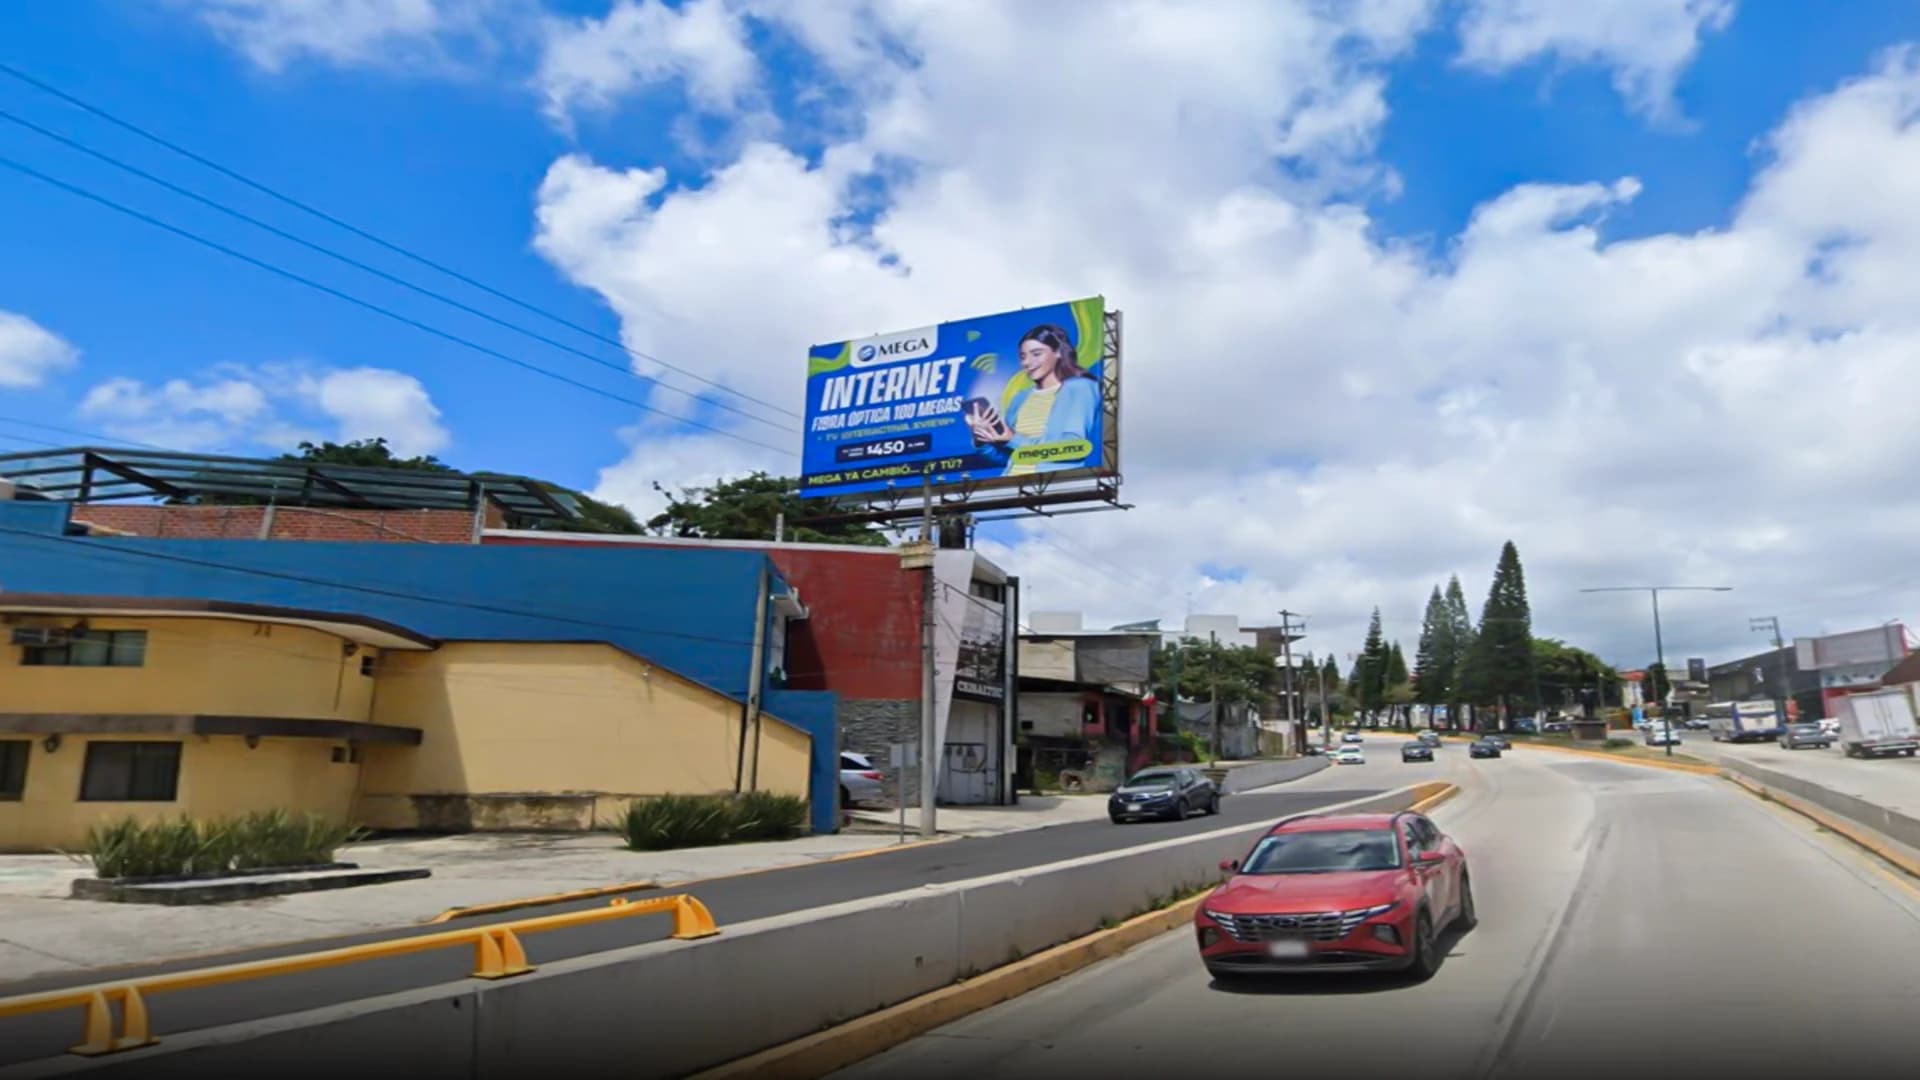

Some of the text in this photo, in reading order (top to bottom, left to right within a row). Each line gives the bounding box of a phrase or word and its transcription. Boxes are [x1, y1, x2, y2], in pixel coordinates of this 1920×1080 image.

[878, 337, 929, 356] MEGA
[820, 356, 966, 411] INTERNET
[811, 412, 846, 432] FIBRA
[894, 402, 916, 421] 100
[917, 396, 963, 417] MEGAS
[826, 433, 839, 442] TV
[867, 440, 905, 456] $450
[1018, 445, 1085, 459] mega.mx
[808, 472, 842, 485] MEGA
[846, 470, 859, 481] YA
[923, 462, 937, 475] ¿Y
[941, 458, 963, 470] TÚ?
